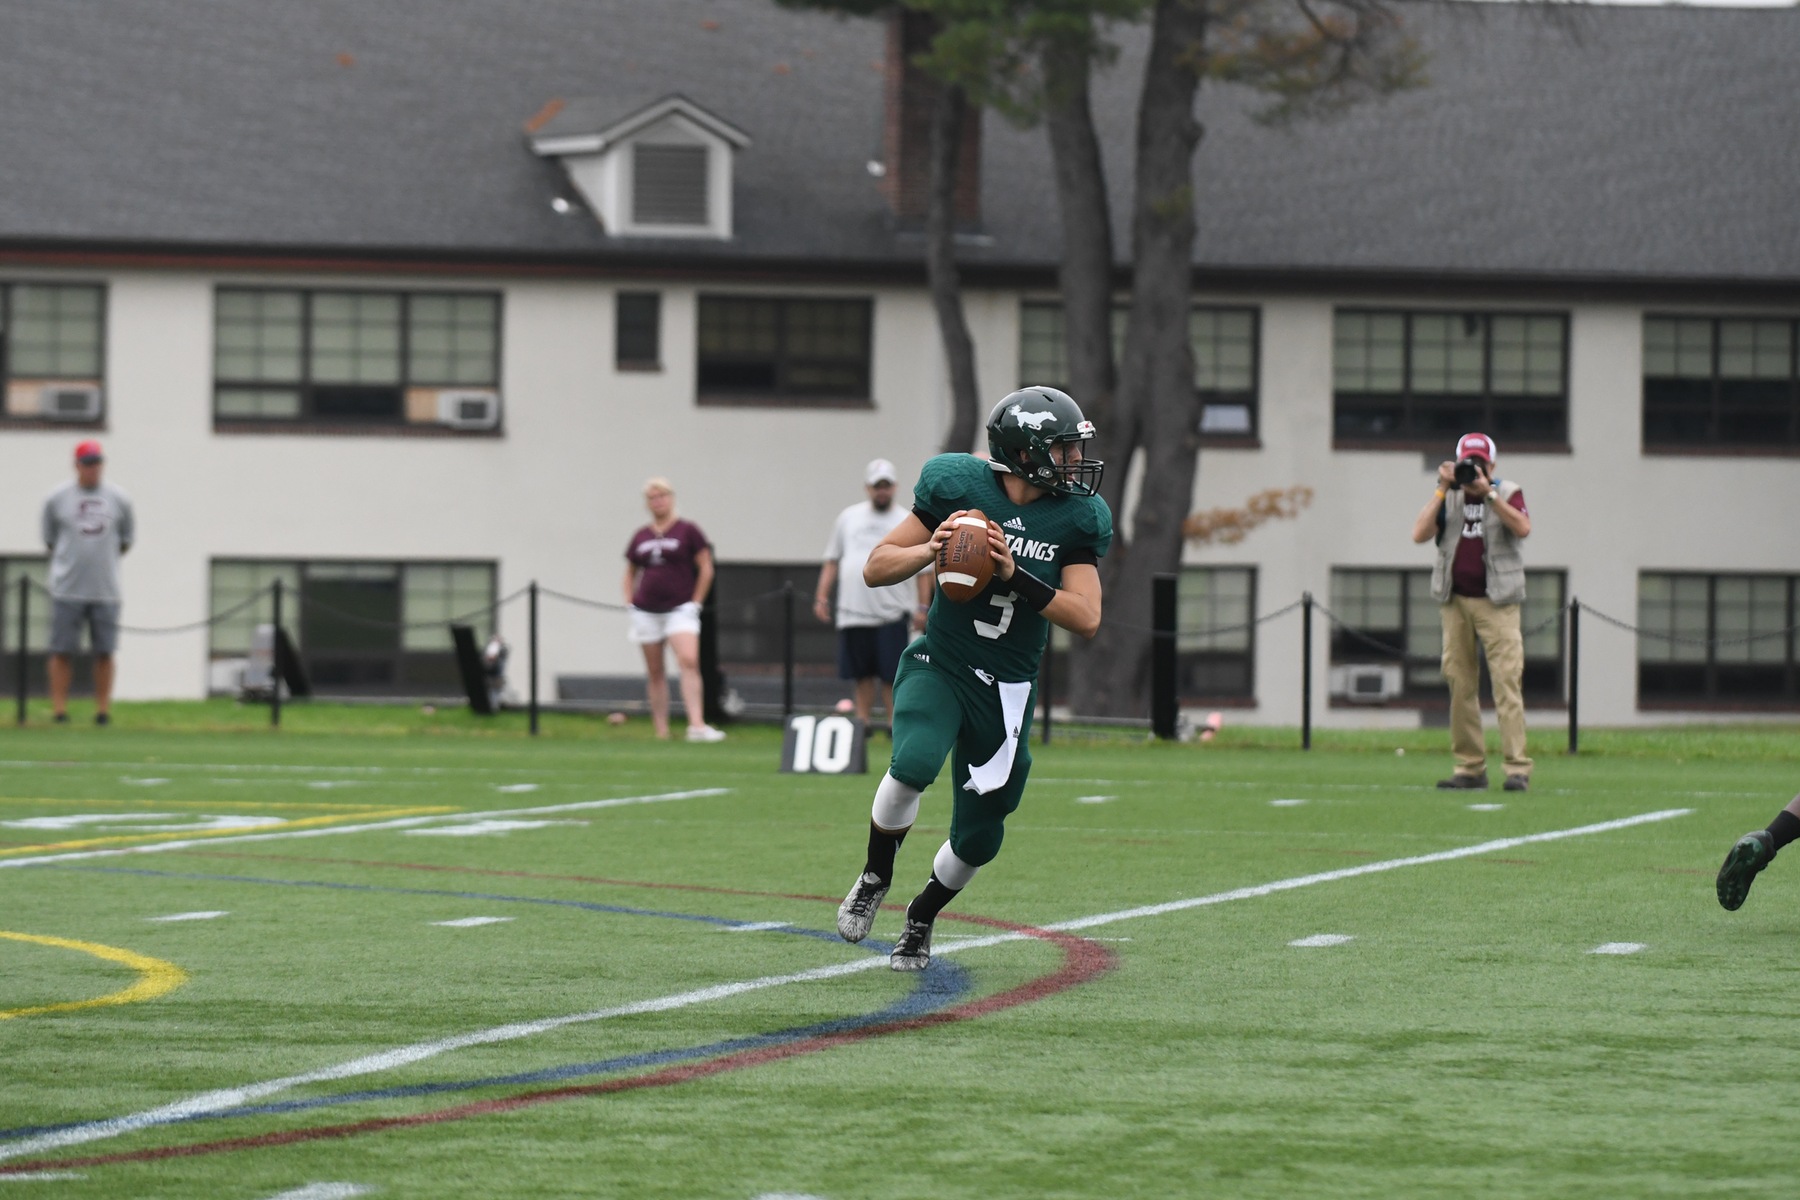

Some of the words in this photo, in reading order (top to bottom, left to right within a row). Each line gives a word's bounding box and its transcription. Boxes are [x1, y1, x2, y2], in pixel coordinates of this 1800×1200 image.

[1002, 521, 1026, 532] adidas
[973, 590, 1018, 640] 3
[791, 715, 854, 774] 10
